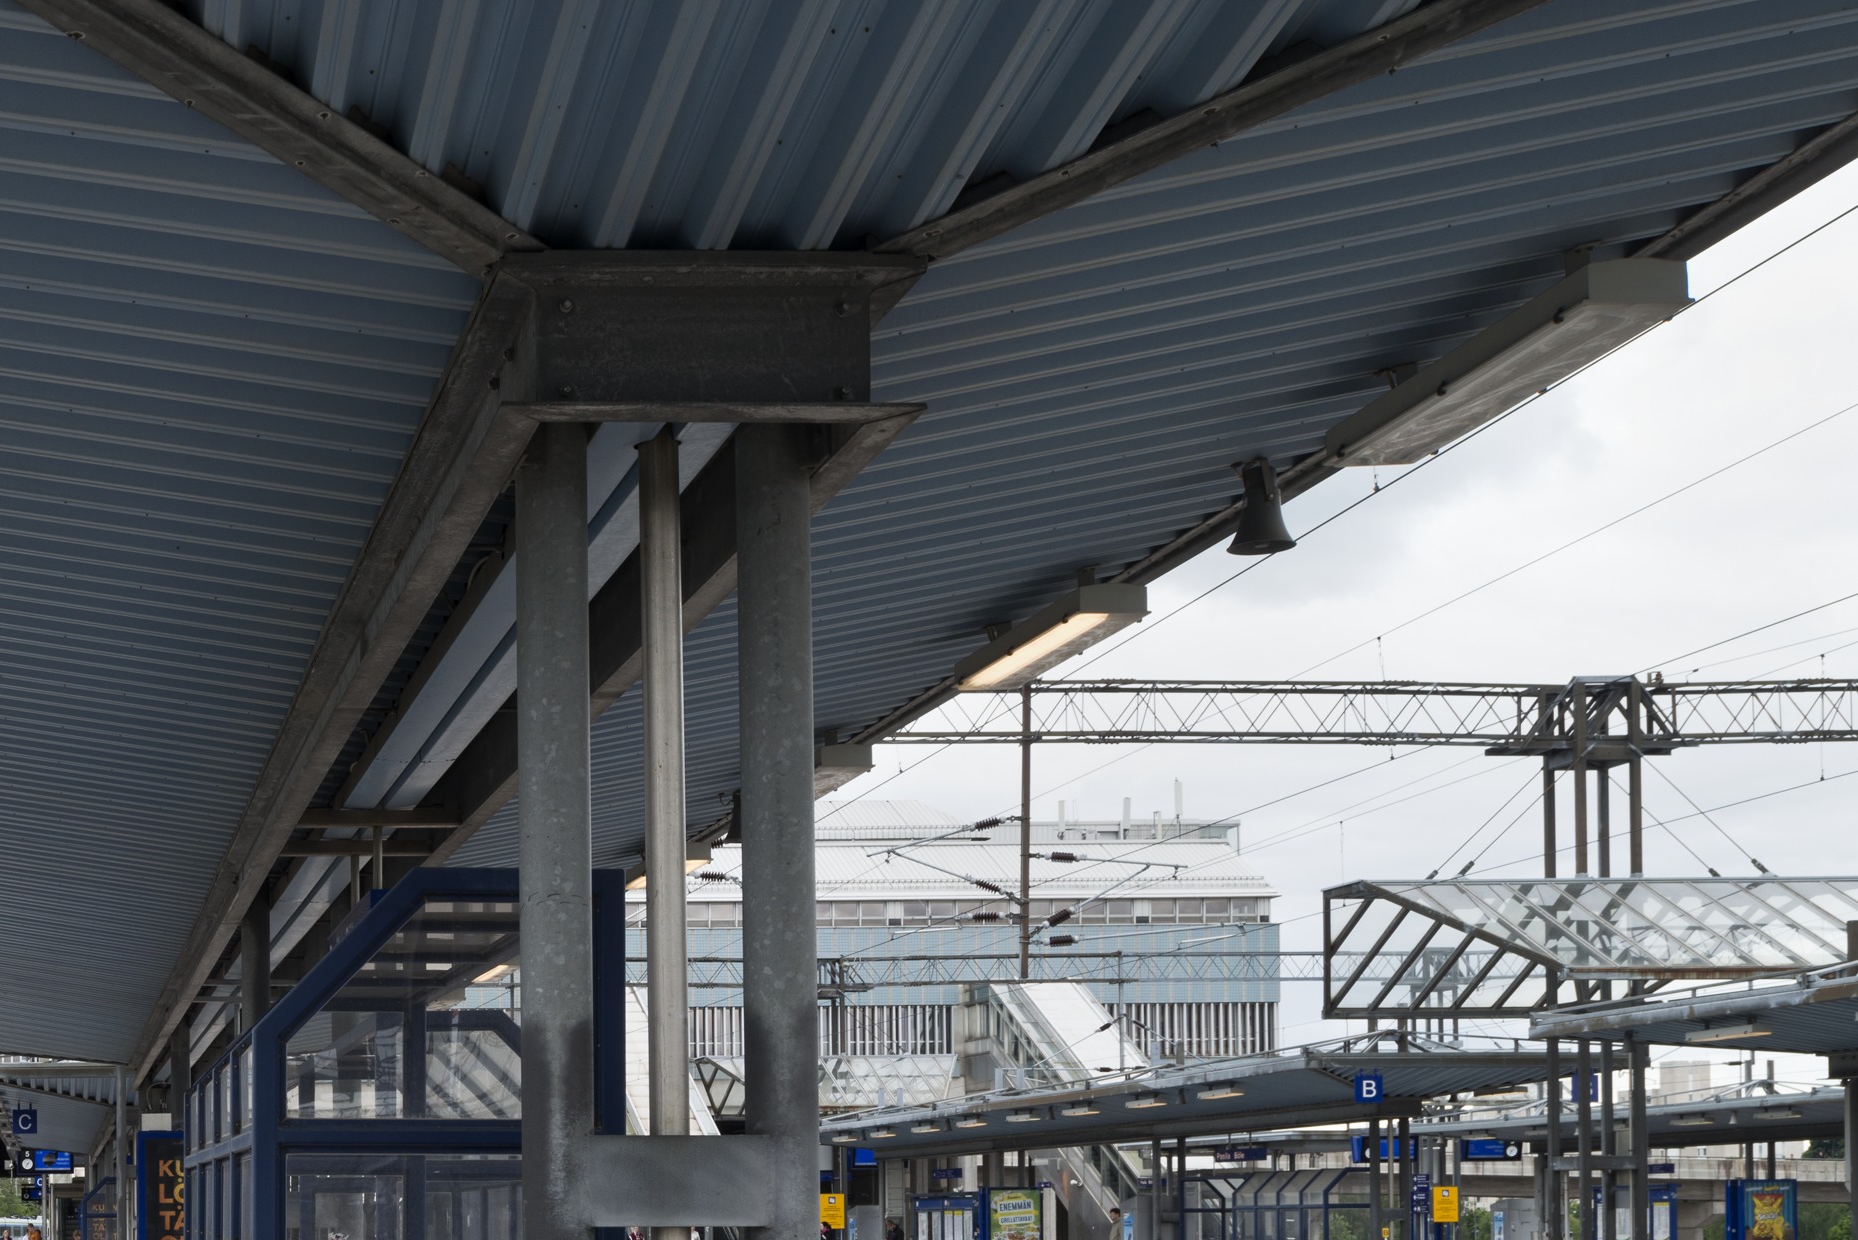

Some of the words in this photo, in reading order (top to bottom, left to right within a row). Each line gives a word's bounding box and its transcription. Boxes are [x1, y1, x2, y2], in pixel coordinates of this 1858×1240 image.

[1362, 1080, 1377, 1098] B
[18, 1114, 32, 1130] C
[999, 1201, 1032, 1212] ENEMMÄN
